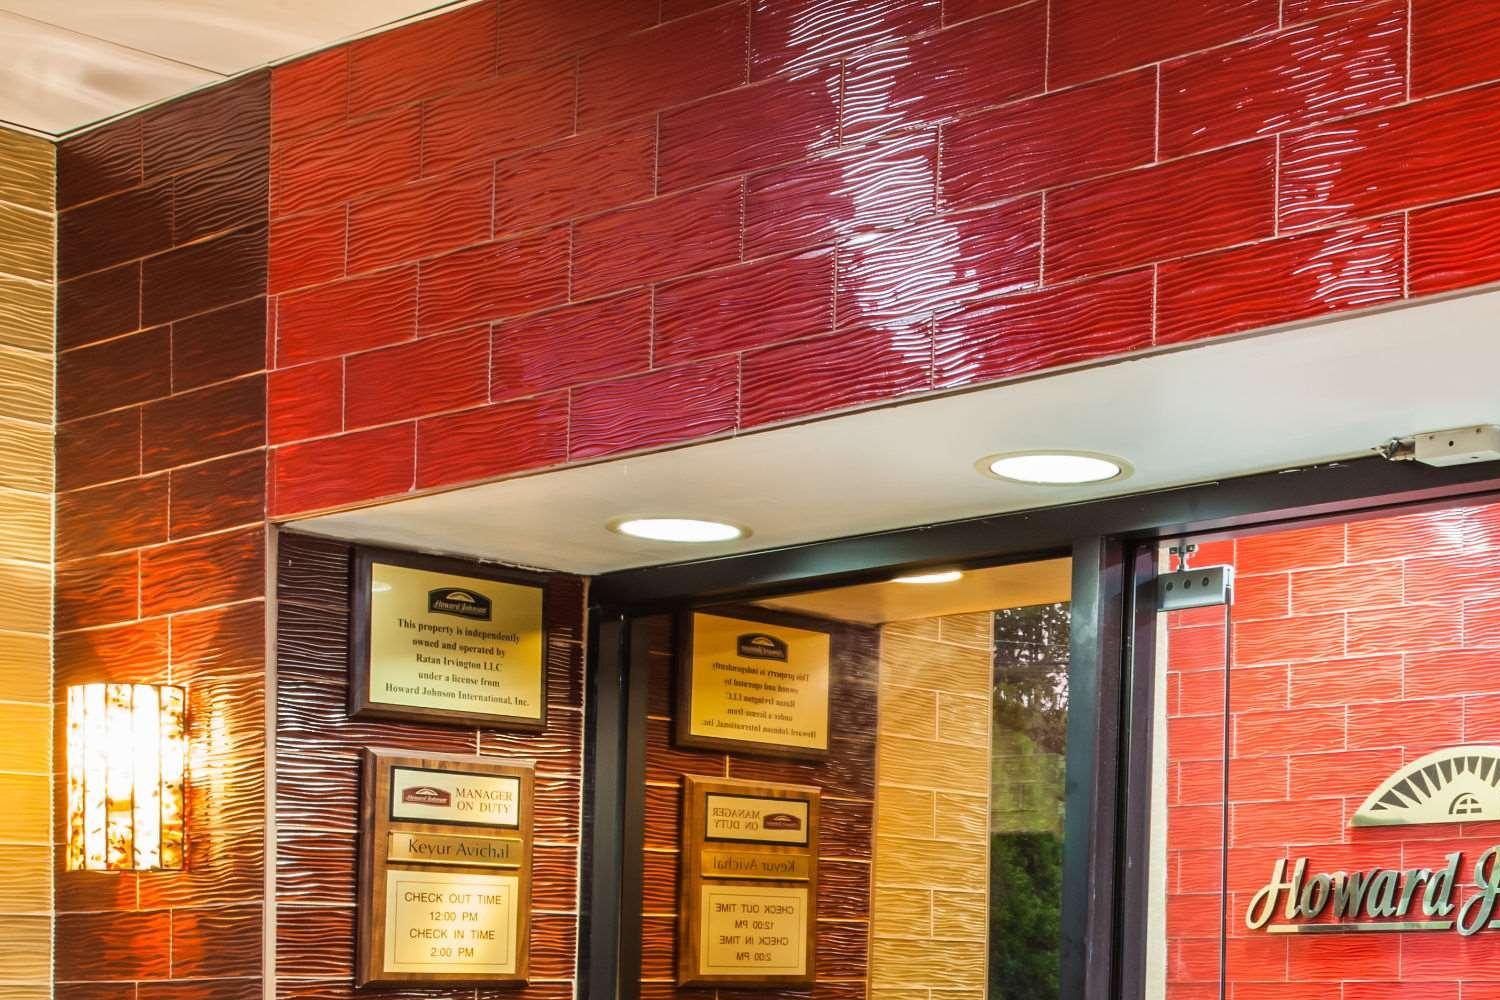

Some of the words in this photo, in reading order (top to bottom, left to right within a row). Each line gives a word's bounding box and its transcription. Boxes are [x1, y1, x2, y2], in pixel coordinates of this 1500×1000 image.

[399, 618, 416, 629] This
[418, 622, 453, 636] property
[456, 625, 462, 635] is
[464, 626, 520, 645] independently
[412, 639, 439, 649] owned
[441, 641, 457, 650] and
[459, 643, 494, 656] operated
[496, 647, 505, 658] by
[416, 653, 441, 665] Ratan
[483, 661, 503, 672] LLC
[418, 671, 442, 681] under
[452, 673, 478, 685] license
[480, 677, 500, 688] from
[385, 682, 420, 695] Howard
[421, 686, 456, 699] Johnson
[456, 786, 513, 802] MANAGER
[457, 800, 473, 811] ON
[479, 802, 511, 815] DUTY
[404, 891, 443, 903] CHECK
[449, 893, 471, 904] OUT
[477, 894, 502, 905] TIME
[1245, 851, 1463, 930] Howard
[430, 911, 457, 921] 12:00
[461, 911, 478, 922] PM
[409, 927, 448, 940] CHECK
[453, 929, 465, 940] IN
[471, 929, 495, 940] TIME
[430, 946, 452, 958] 2:00
[457, 947, 474, 958] PM
